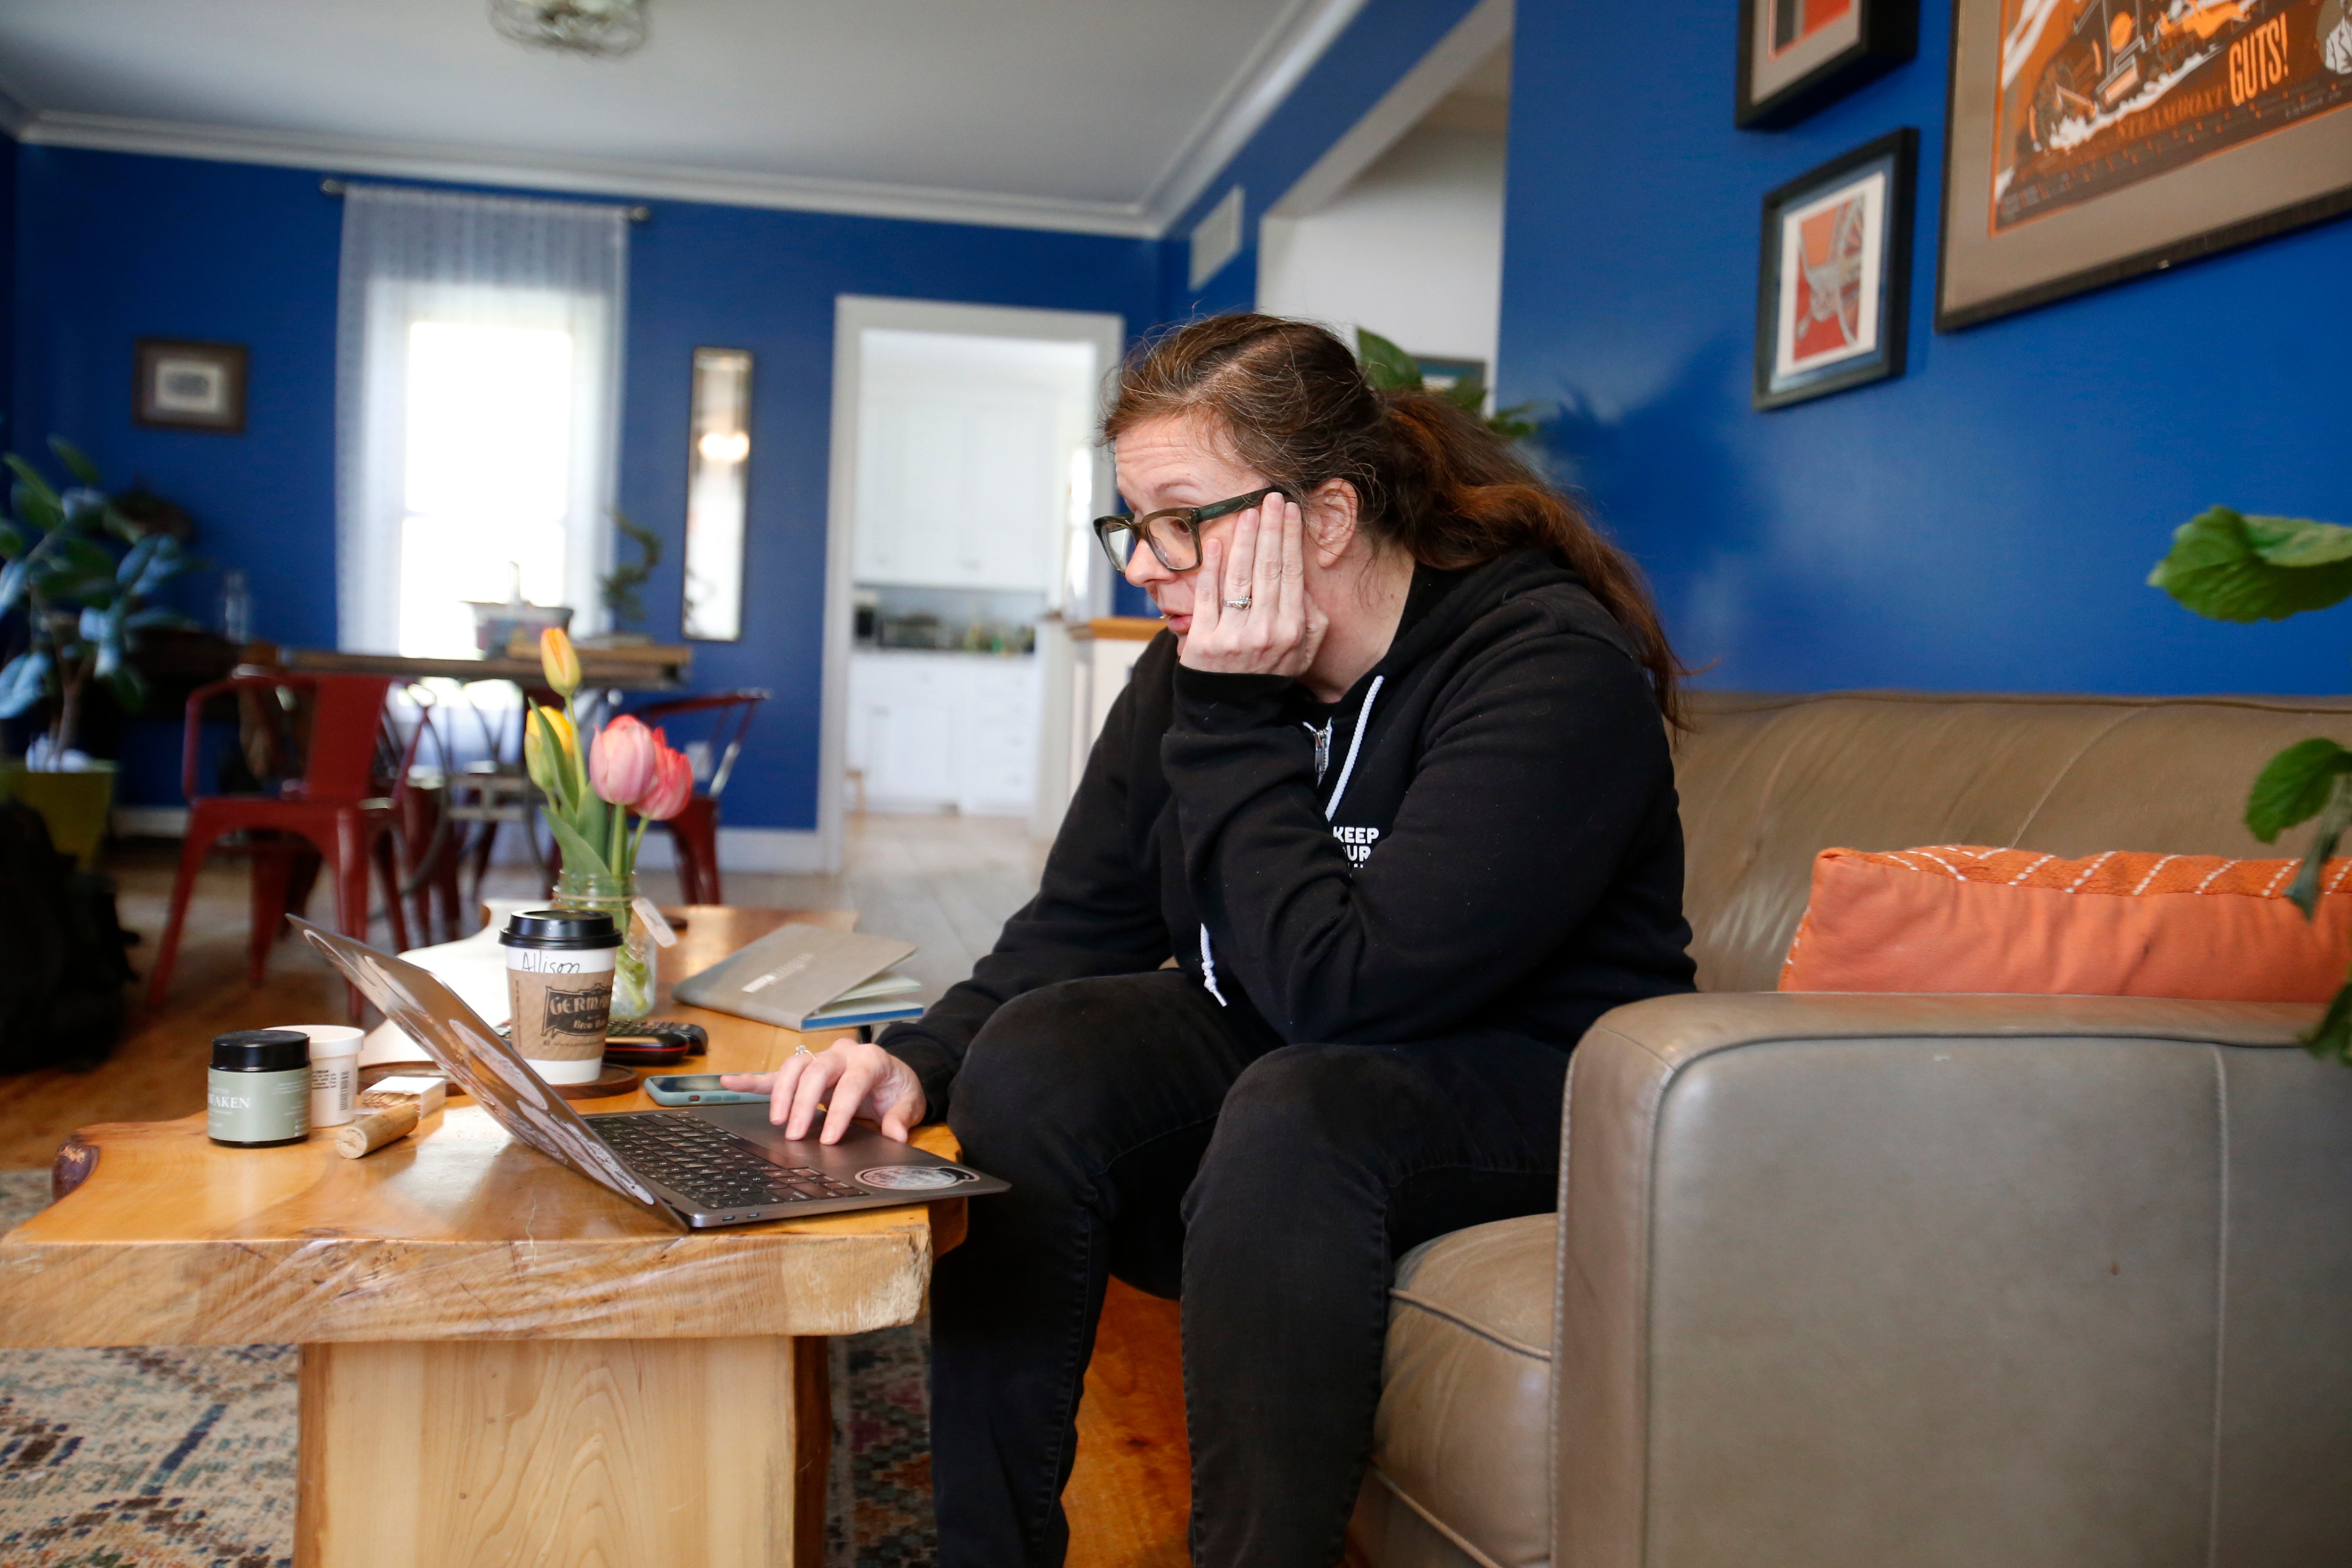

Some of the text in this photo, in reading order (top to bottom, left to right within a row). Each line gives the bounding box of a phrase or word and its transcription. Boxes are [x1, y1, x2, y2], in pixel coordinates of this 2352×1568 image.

[2229, 12, 2289, 107] GUTS!
[1333, 826, 1379, 844] KEEP
[522, 950, 580, 974] Allison
